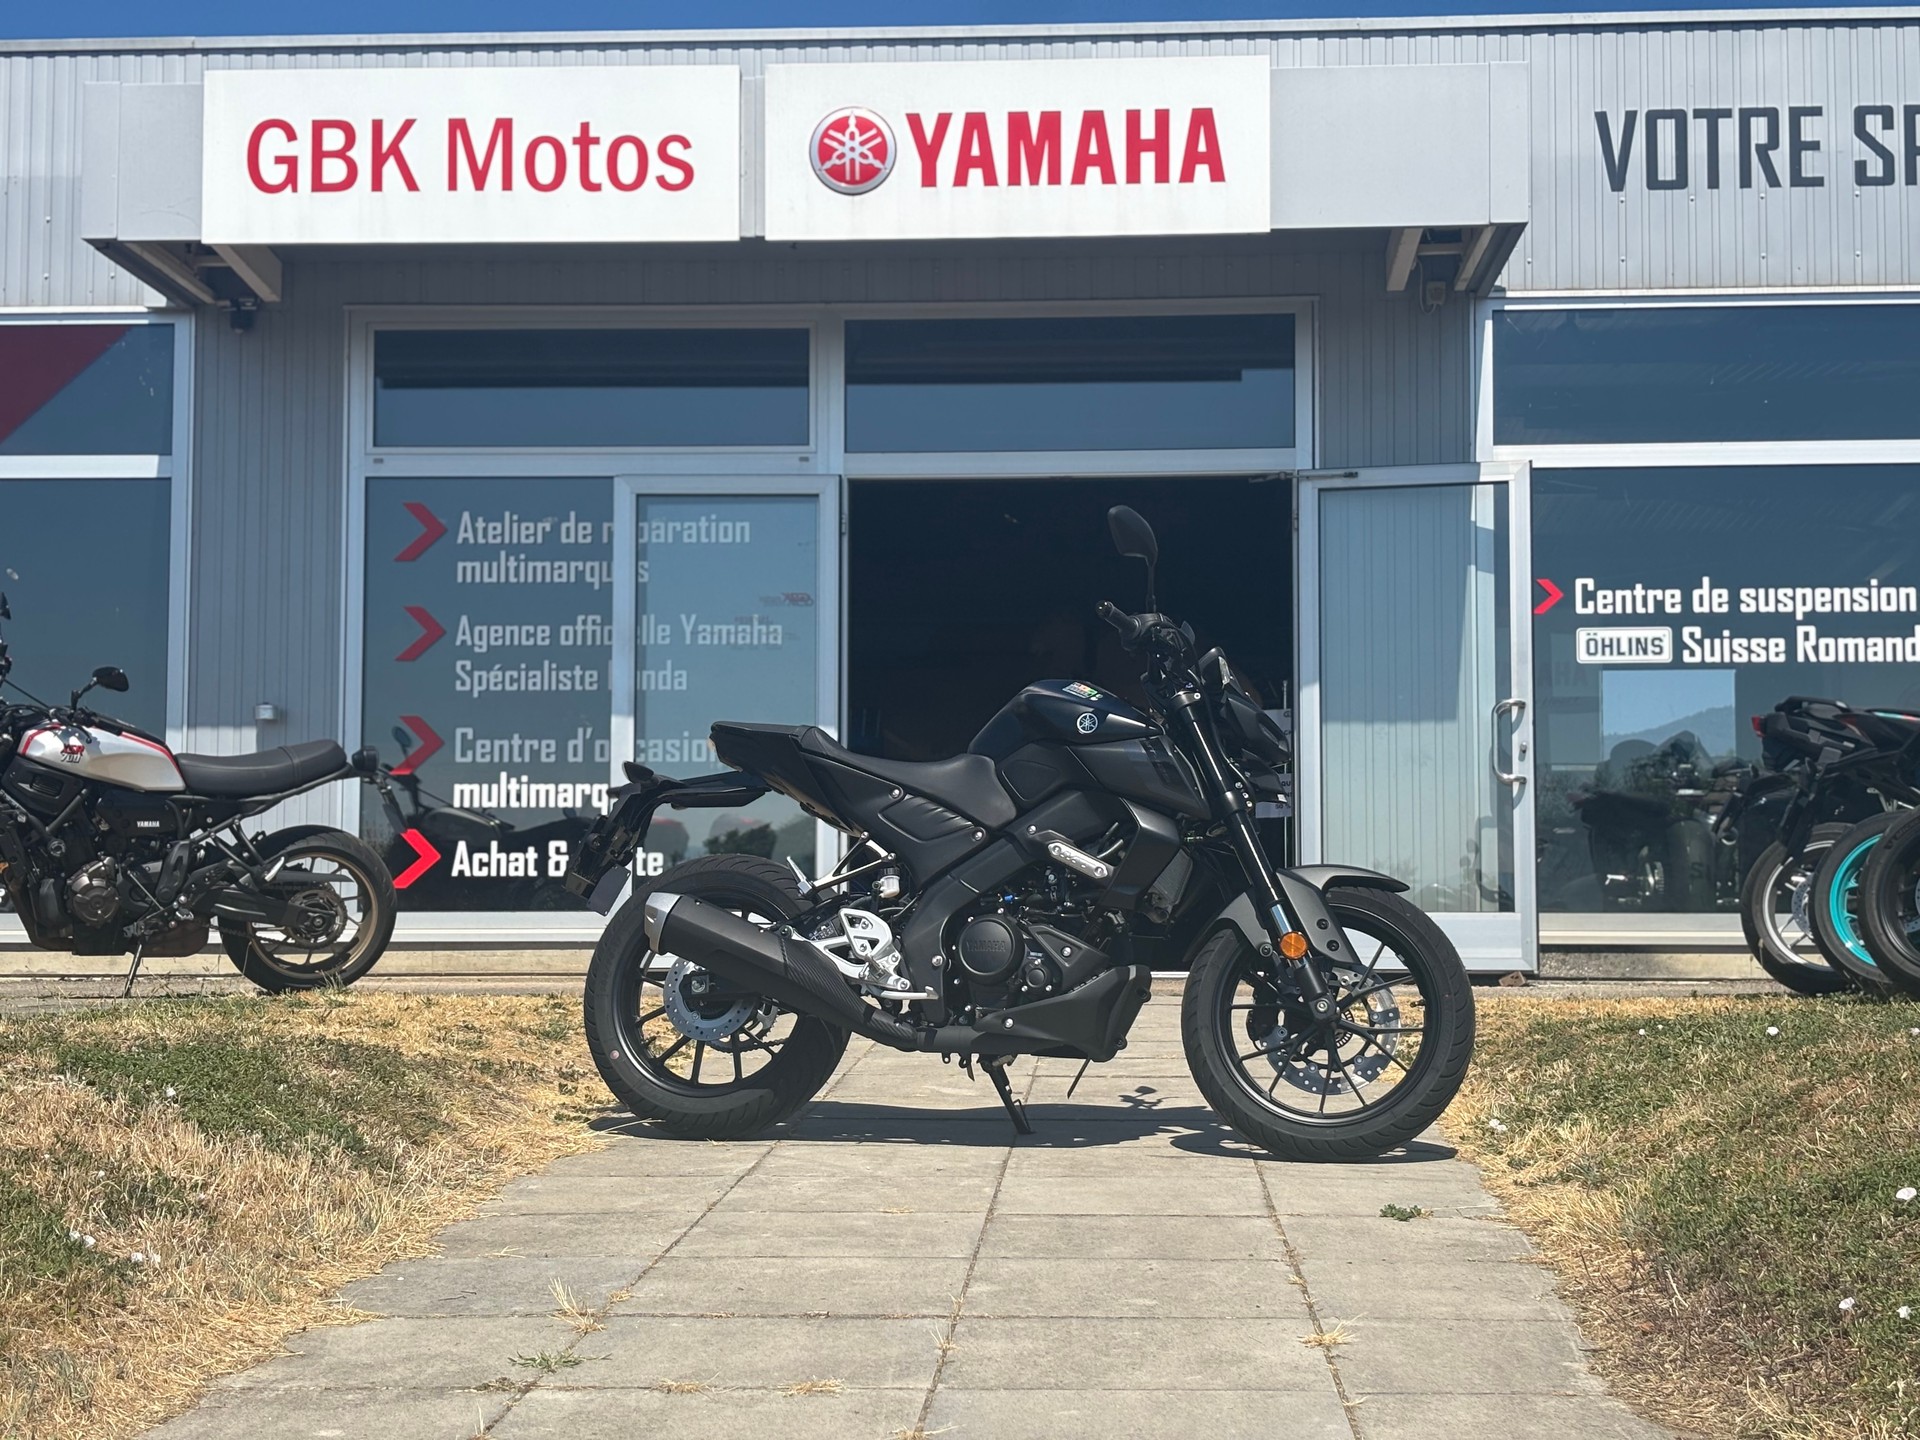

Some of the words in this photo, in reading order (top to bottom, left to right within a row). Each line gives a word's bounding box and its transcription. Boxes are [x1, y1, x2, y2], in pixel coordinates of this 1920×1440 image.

[246, 118, 420, 194] GBK
[447, 117, 695, 193] Motos
[905, 107, 1226, 188] YAMAHA
[1594, 105, 1825, 192] VOTRE
[456, 510, 552, 544] Atelier
[560, 510, 593, 544] de
[602, 513, 751, 544] rparation
[456, 550, 650, 590] multimarqus
[1574, 577, 1682, 614] Centre
[1692, 576, 1729, 613] de
[1739, 578, 1918, 621] suspension
[455, 614, 551, 653] Agence
[559, 613, 671, 646] officlle
[680, 612, 783, 646] Yamaha
[1585, 632, 1665, 657] ÖHLINS
[1682, 625, 1786, 664] Suisse
[455, 659, 599, 699] Spécialiste
[454, 727, 557, 763] Centre
[453, 771, 609, 816] multimarq
[136, 820, 160, 828] YAMAHA
[451, 839, 538, 877] Achat
[547, 839, 570, 877] &
[966, 940, 1006, 952] YAMAHA
